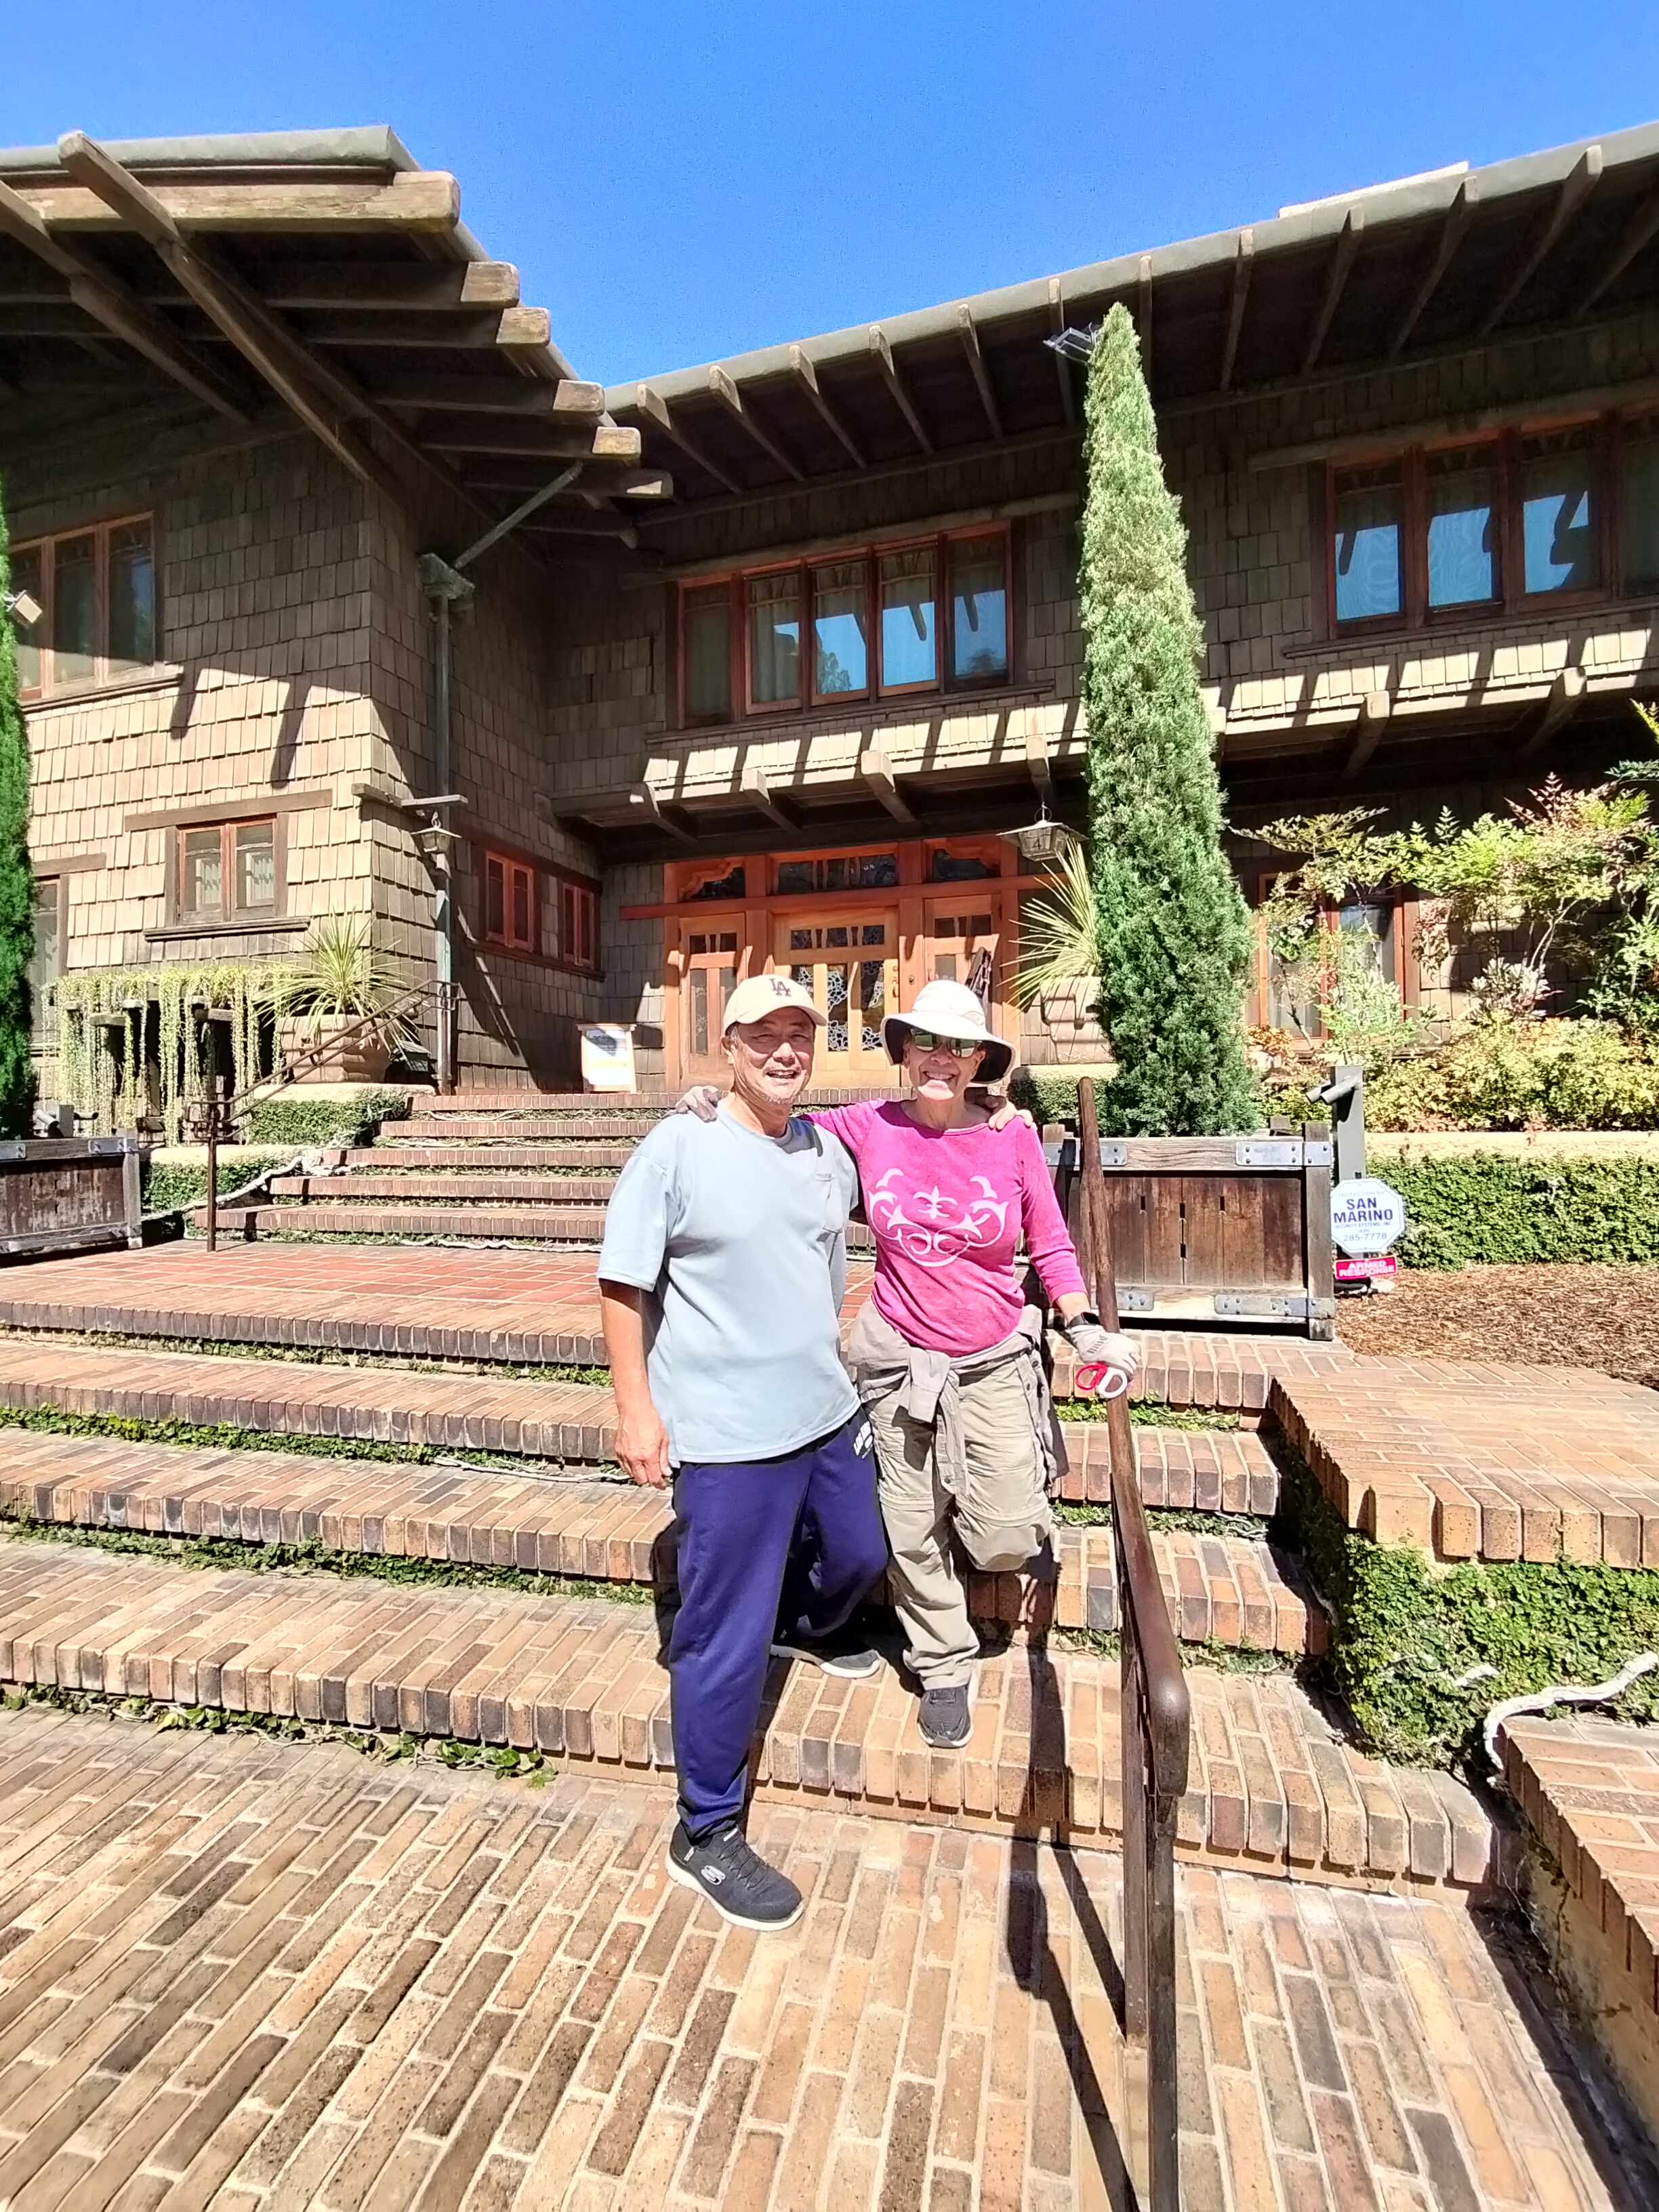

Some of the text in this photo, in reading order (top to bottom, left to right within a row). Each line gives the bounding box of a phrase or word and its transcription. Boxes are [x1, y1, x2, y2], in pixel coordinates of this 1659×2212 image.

[1032, 838, 1042, 851] 4
[769, 978, 792, 997] LA
[1346, 1197, 1377, 1210] SAN
[1333, 1208, 1393, 1223] MARINO
[1343, 1232, 1387, 1242] 285-7778
[1338, 1265, 1395, 1276] RESPONSE
[1348, 1260, 1387, 1269] ARMED
